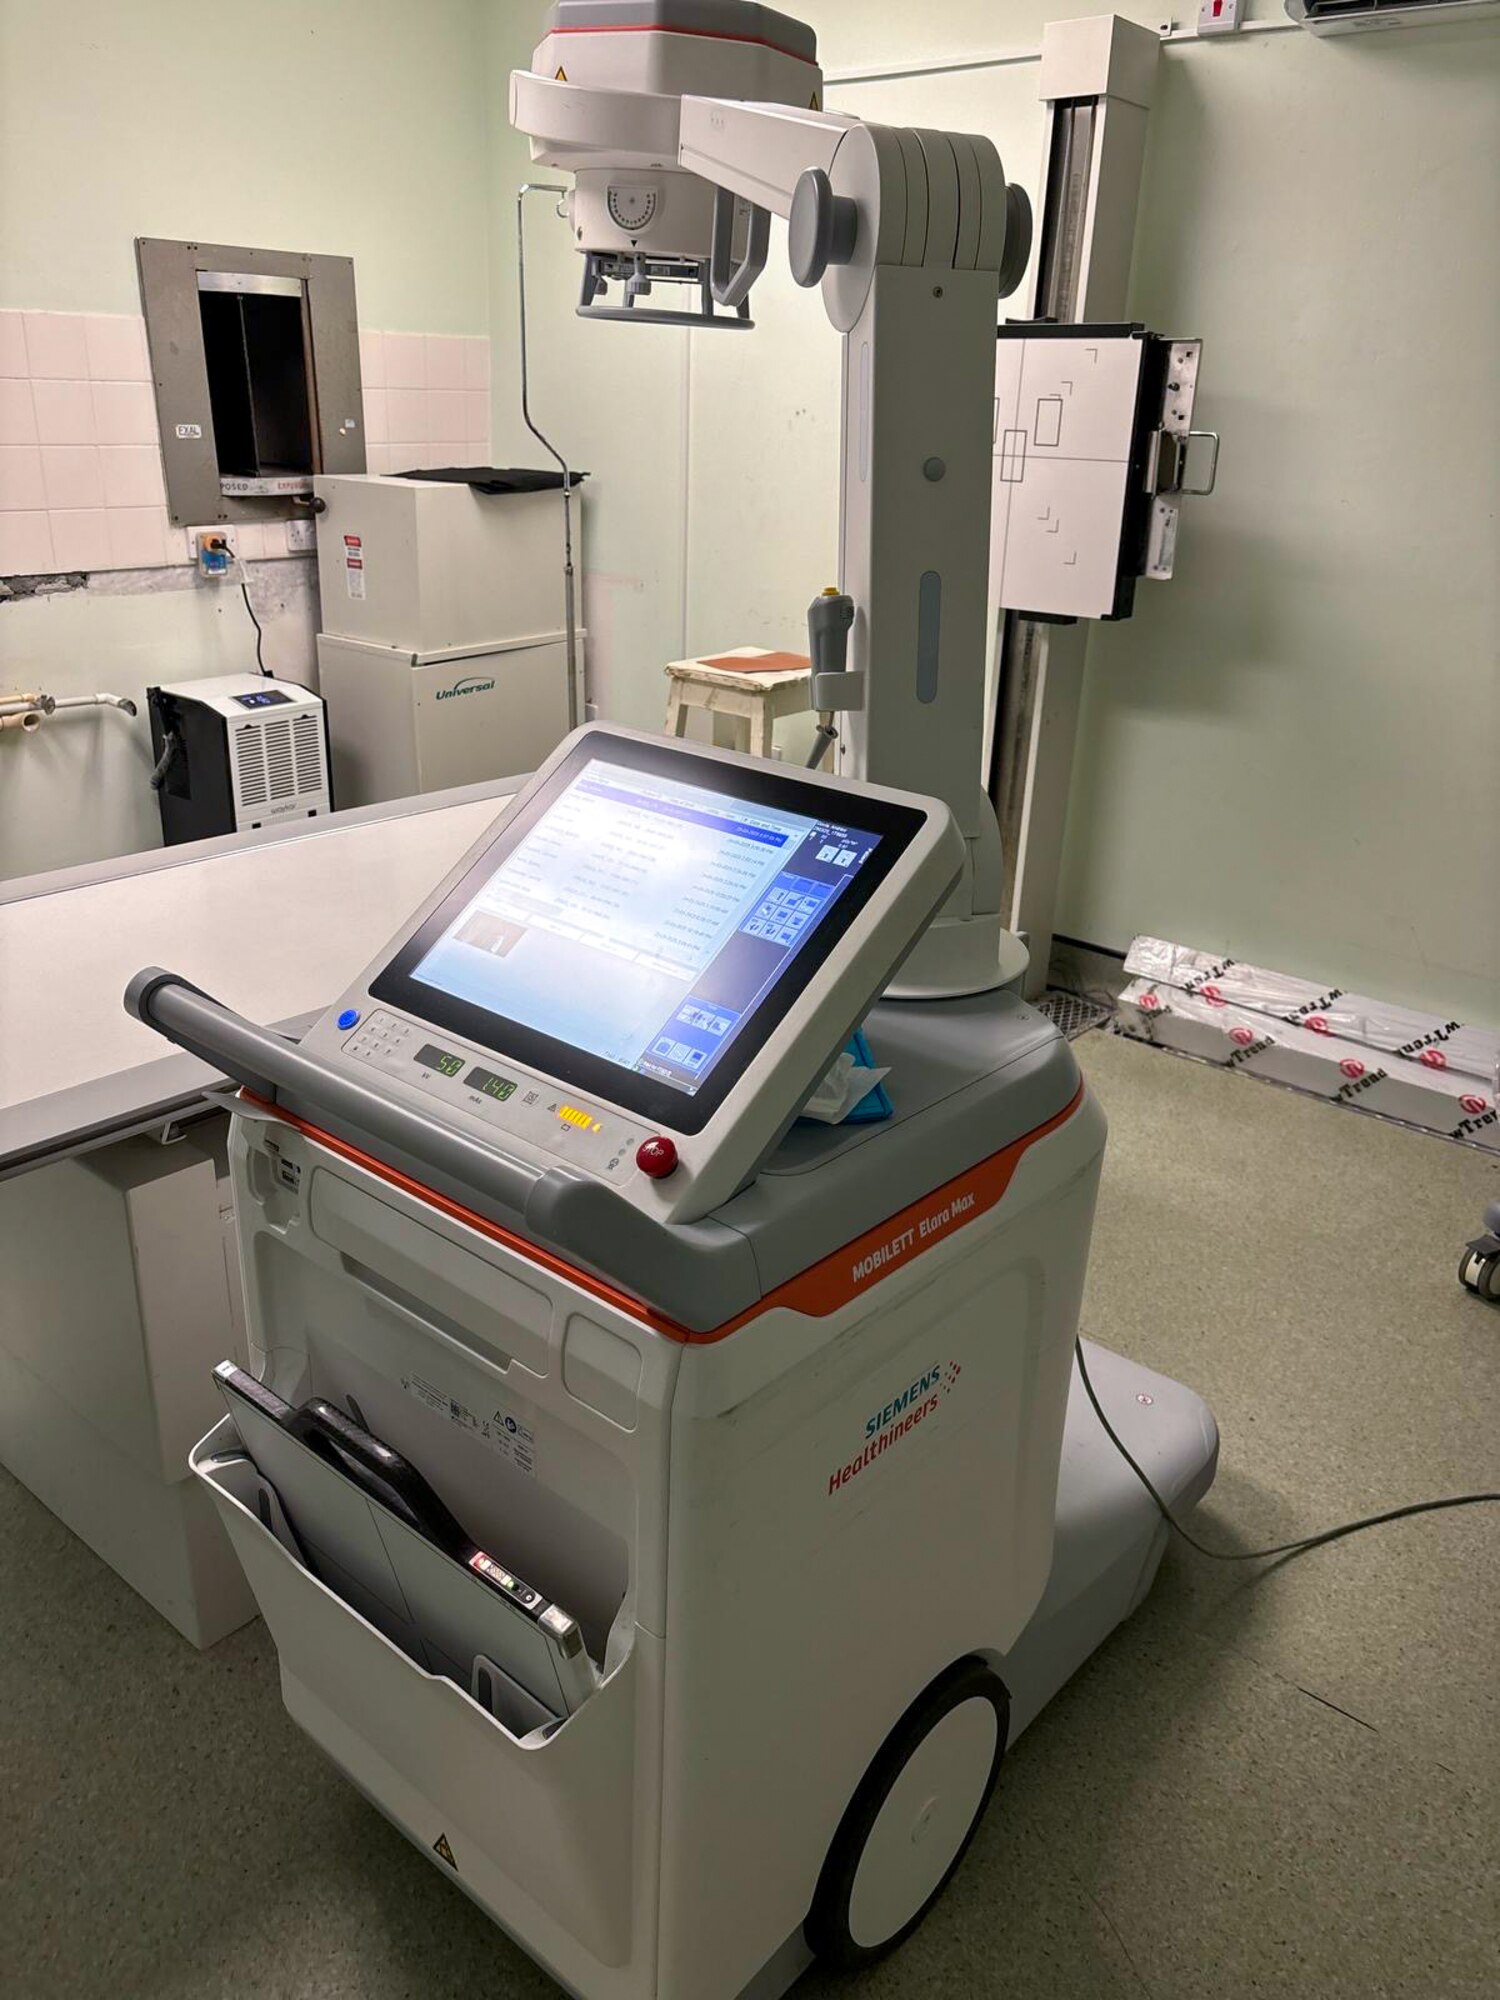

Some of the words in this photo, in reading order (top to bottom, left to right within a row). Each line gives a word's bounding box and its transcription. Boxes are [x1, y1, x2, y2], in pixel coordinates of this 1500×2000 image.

[436, 680, 495, 700] Universal
[436, 1054, 462, 1077] 50
[852, 1228, 915, 1283] MOBILETT
[919, 1209, 950, 1238] Elara
[951, 1192, 976, 1217] Max
[865, 1365, 940, 1439] SIEMENS
[828, 1394, 938, 1496] Healthineers
